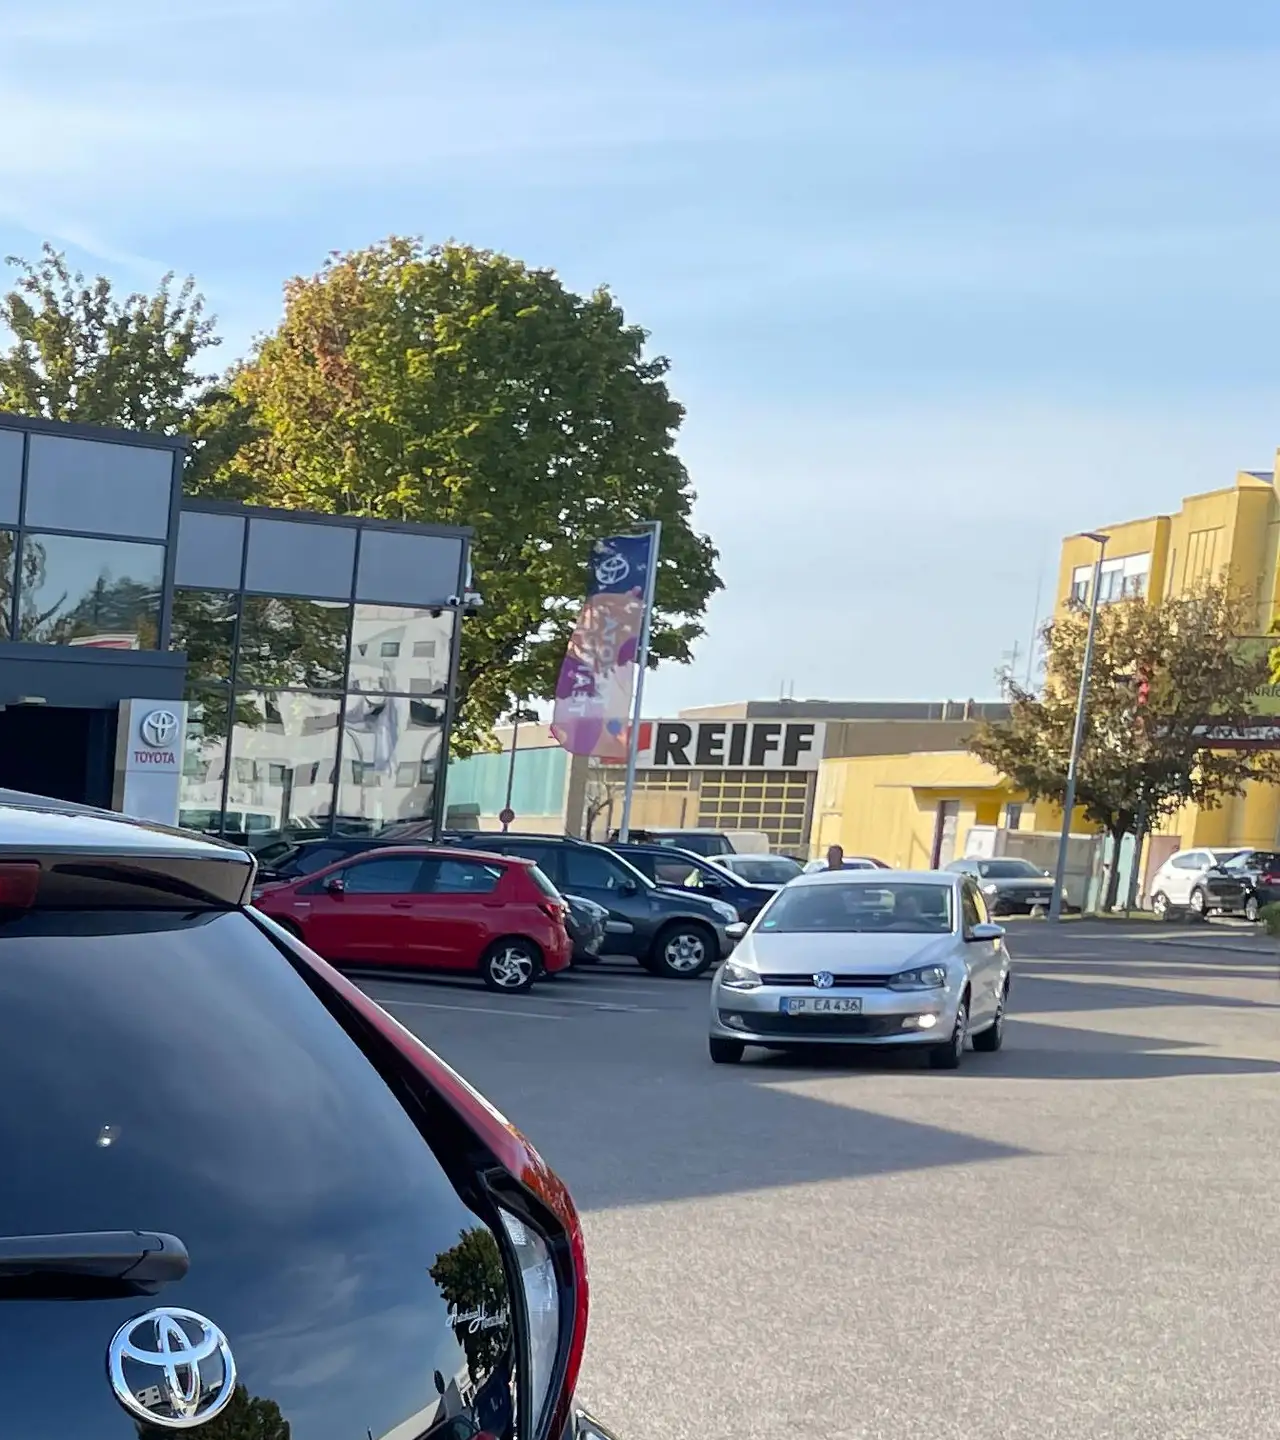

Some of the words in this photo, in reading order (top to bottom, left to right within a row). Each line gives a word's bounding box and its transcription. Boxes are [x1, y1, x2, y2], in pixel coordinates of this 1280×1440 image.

[654, 722, 815, 767] REIFF
[134, 751, 175, 764] TOYOTA
[789, 1000, 805, 1010] GP
